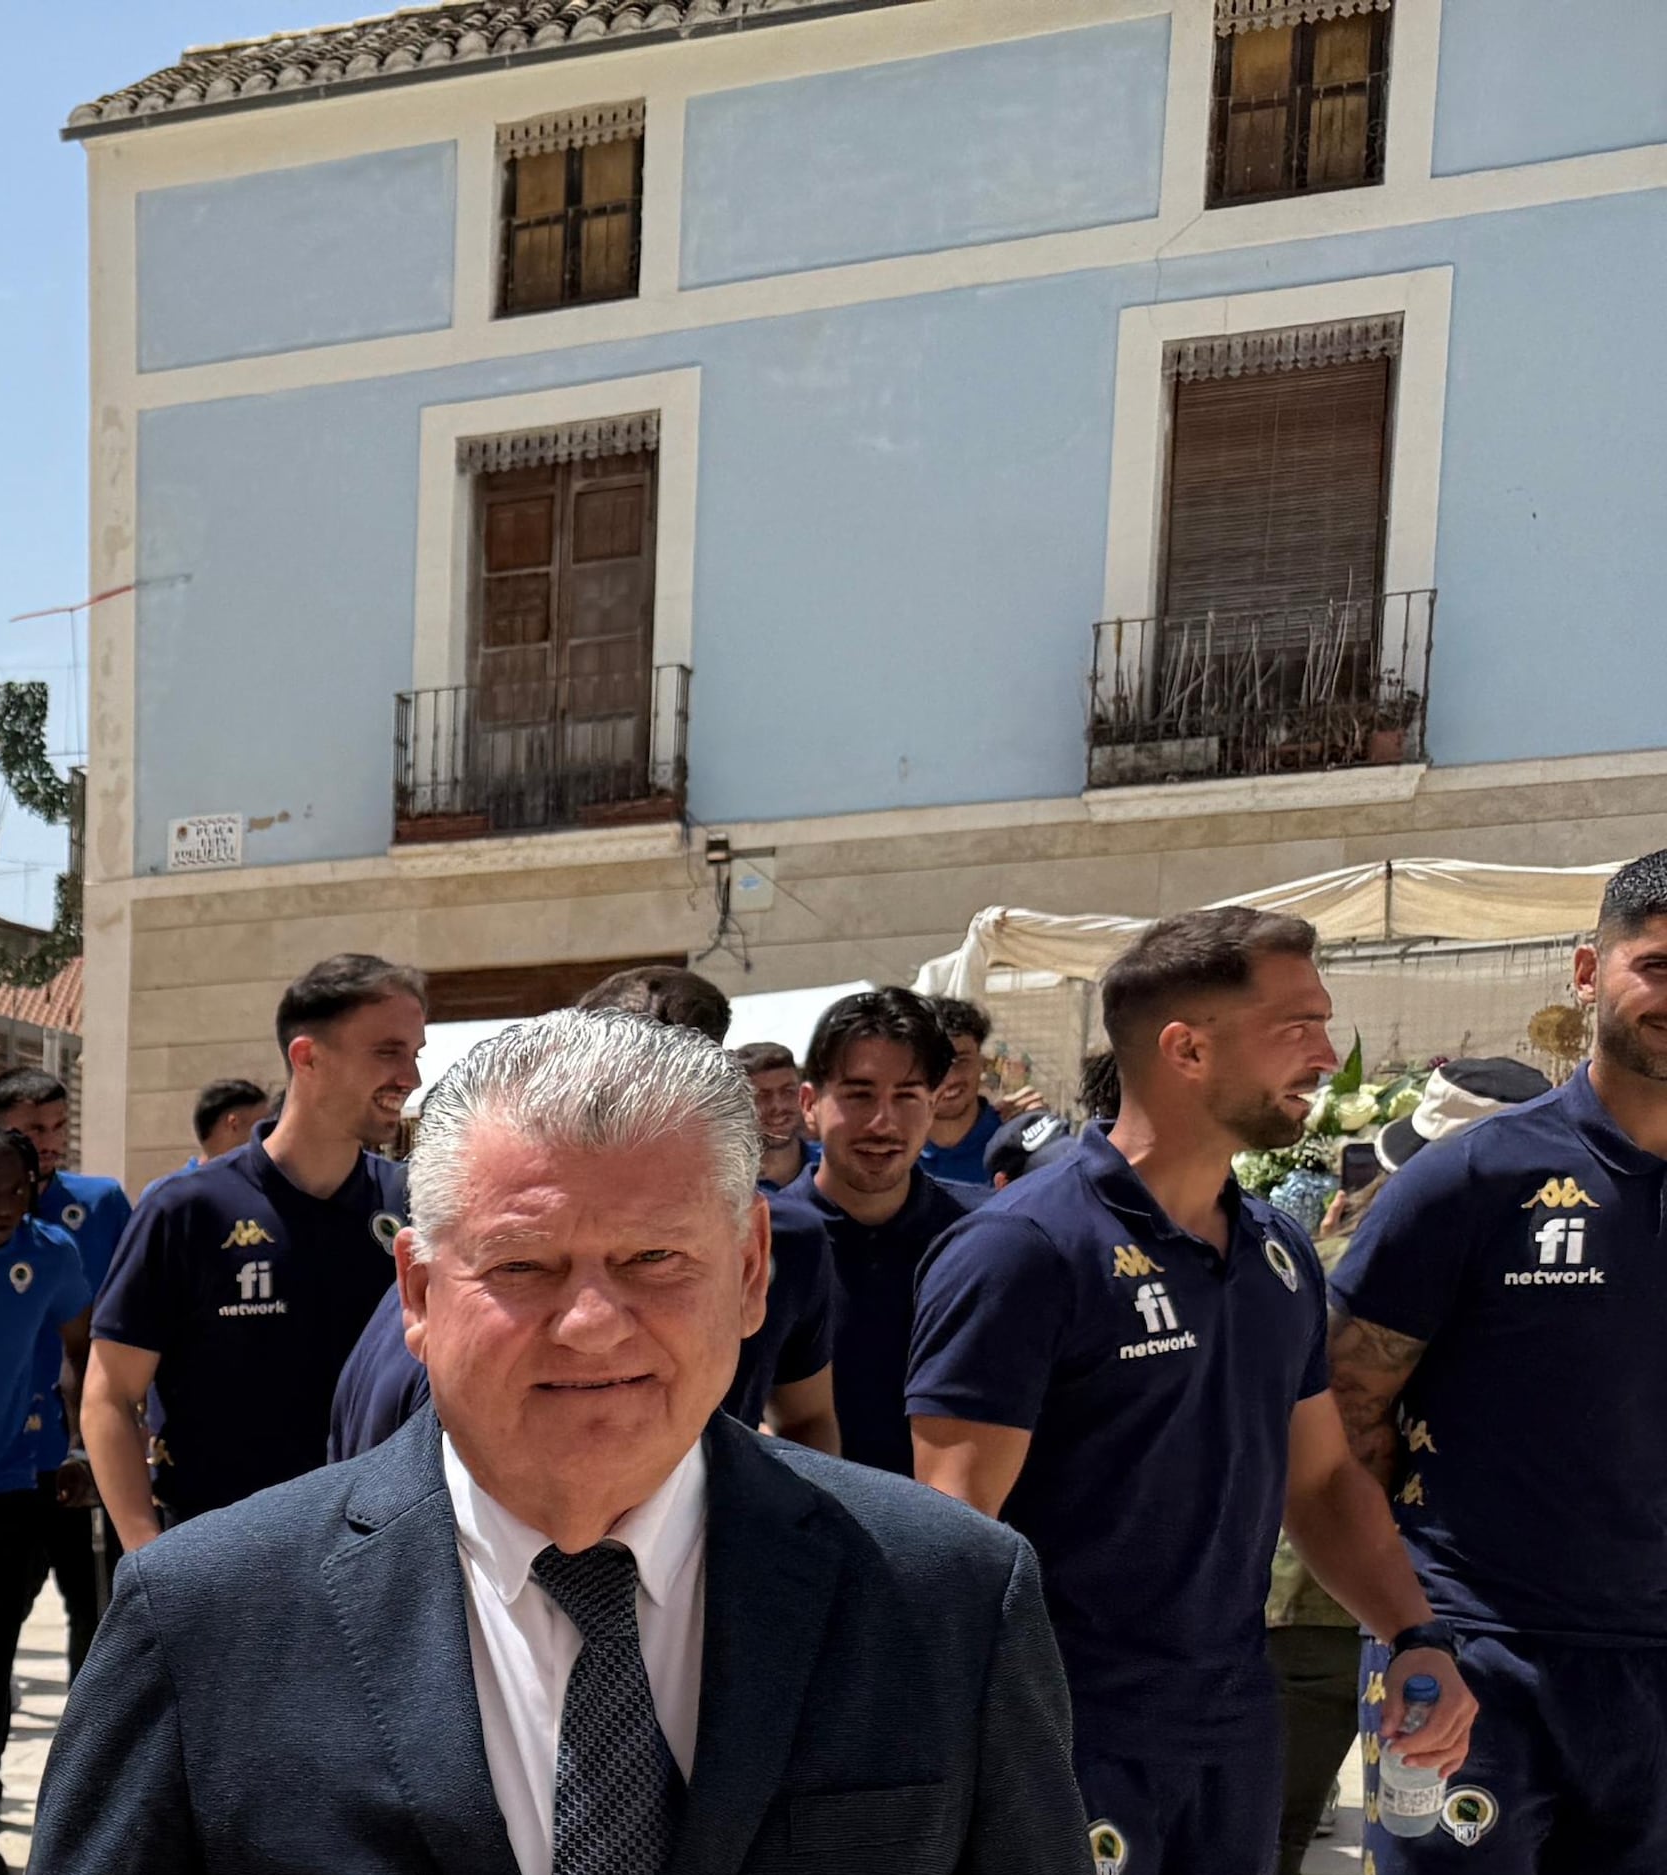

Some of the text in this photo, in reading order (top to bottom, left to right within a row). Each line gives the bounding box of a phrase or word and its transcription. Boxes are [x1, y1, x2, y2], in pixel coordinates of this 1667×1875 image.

[1534, 1217, 1585, 1264] fi
[236, 1260, 272, 1300] fi
[1504, 1267, 1606, 1286] network
[218, 1299, 287, 1317] network
[1134, 1281, 1178, 1334] fi
[1119, 1330, 1198, 1360] network
